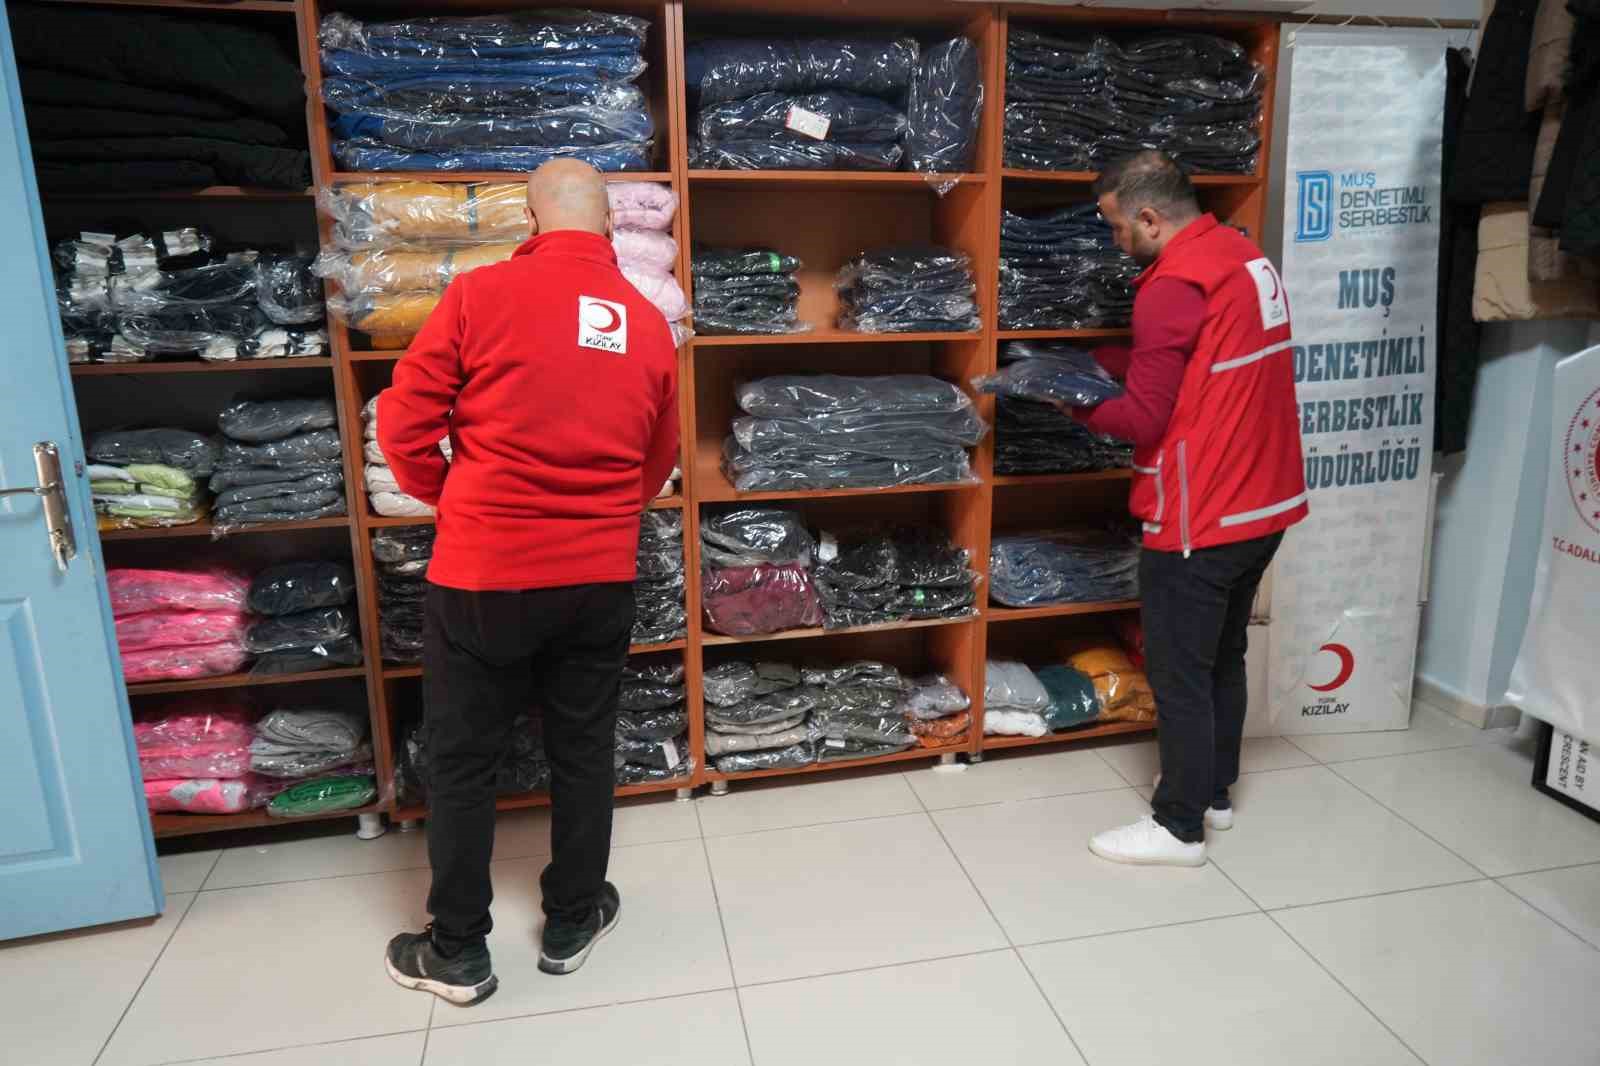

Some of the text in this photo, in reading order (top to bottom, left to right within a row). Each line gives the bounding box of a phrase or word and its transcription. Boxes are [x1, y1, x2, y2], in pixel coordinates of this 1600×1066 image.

[1340, 172, 1376, 188] MUŞ
[1338, 267, 1396, 317] MUŞ
[1293, 325, 1425, 383] DENETİMLİ
[1297, 384, 1423, 434] ERBESTLİK
[1305, 437, 1421, 490] ÜDÜRLÜĞÜ
[1301, 703, 1350, 717] KIZILAY
[1558, 734, 1573, 789] CRESCENT
